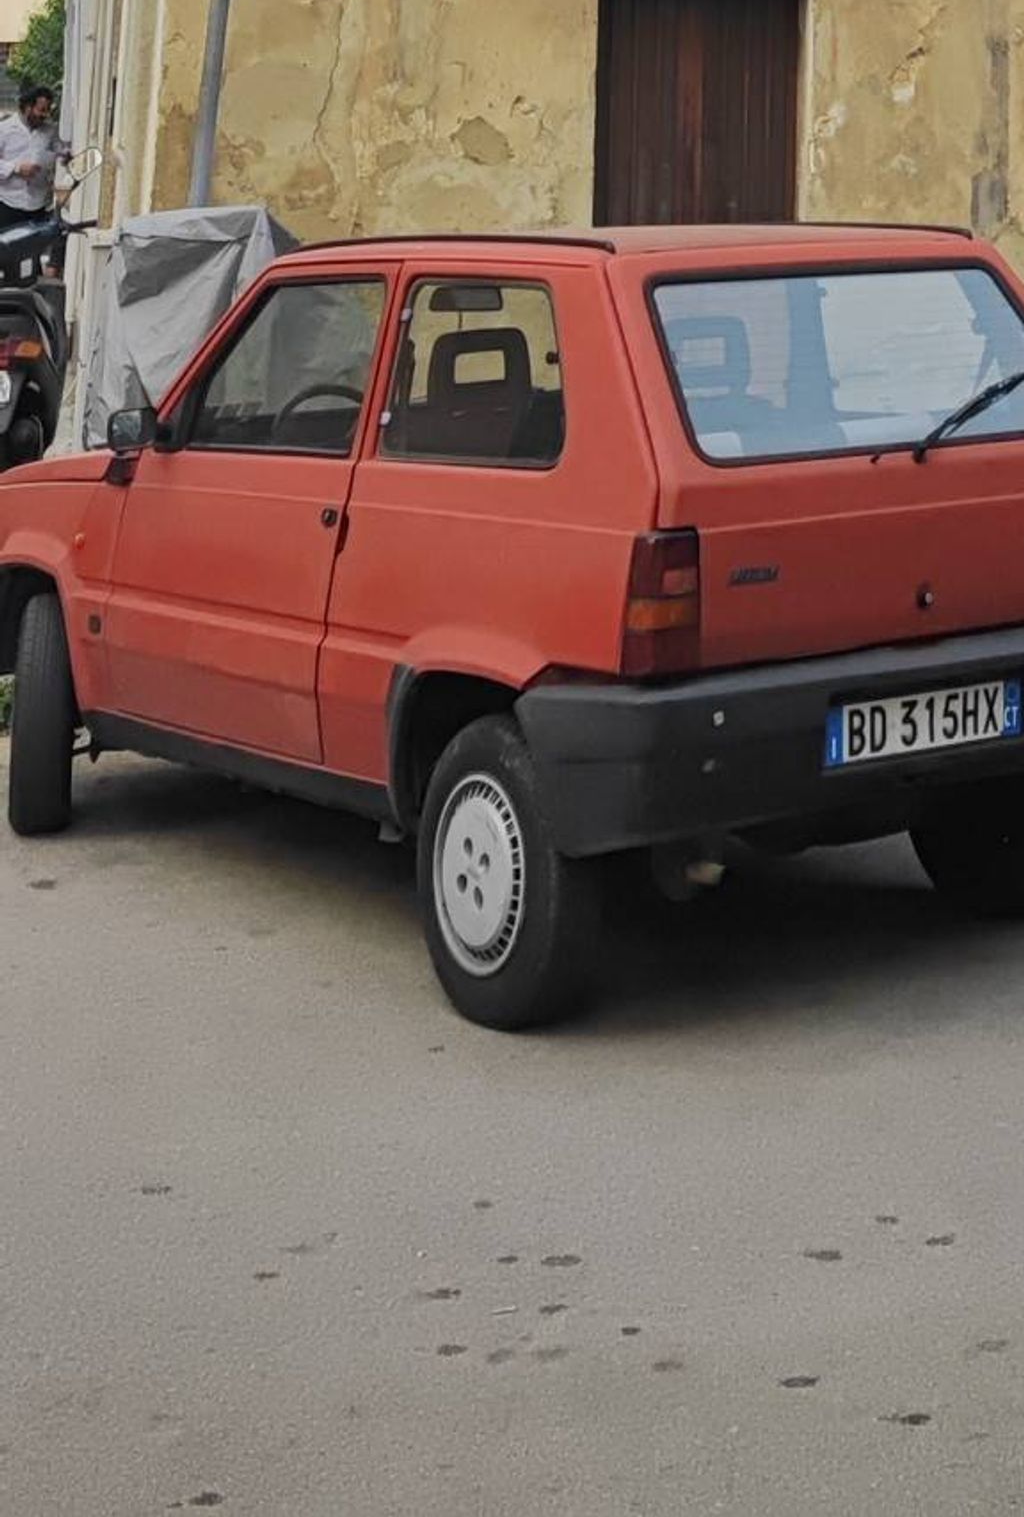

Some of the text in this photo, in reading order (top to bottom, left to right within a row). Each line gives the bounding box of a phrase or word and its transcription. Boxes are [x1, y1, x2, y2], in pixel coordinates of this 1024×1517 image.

[850, 706, 887, 757] BD
[901, 686, 1000, 747] 315HX
[1004, 706, 1019, 727] CT
